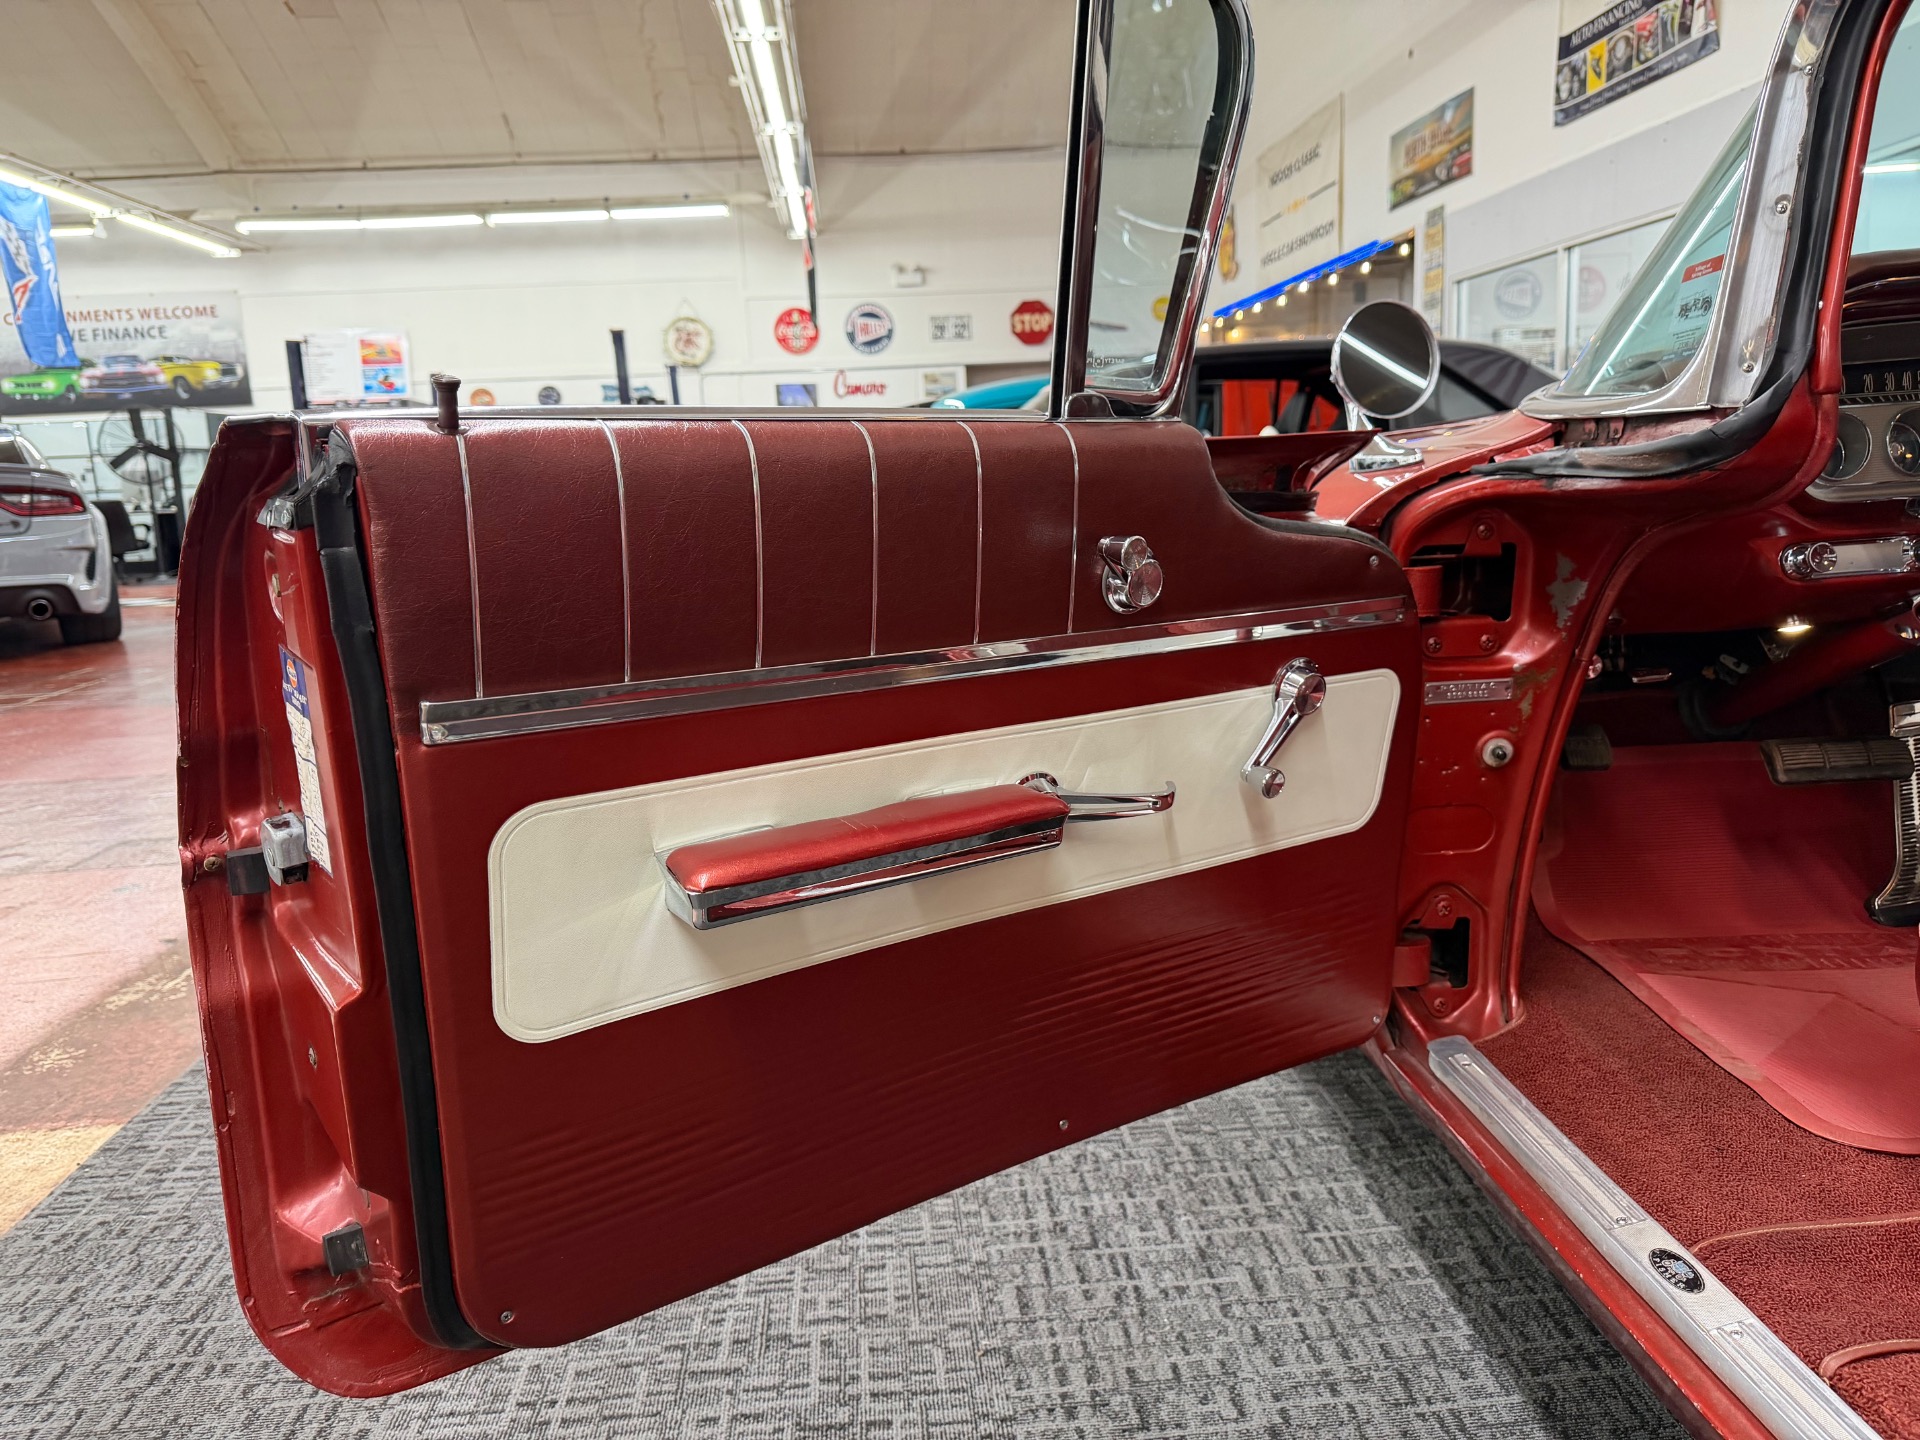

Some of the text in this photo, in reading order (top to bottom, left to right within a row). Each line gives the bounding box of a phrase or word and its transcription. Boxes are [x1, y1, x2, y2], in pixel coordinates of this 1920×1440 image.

[138, 304, 219, 321] WELCOME
[1013, 312, 1051, 333] STOP
[93, 325, 168, 342] FINANCE
[834, 369, 887, 399] Camaro
[1863, 373, 1874, 393] 20
[1884, 371, 1895, 391] 30
[1902, 370, 1912, 391] 40
[1652, 1256, 1687, 1289] FISHER
